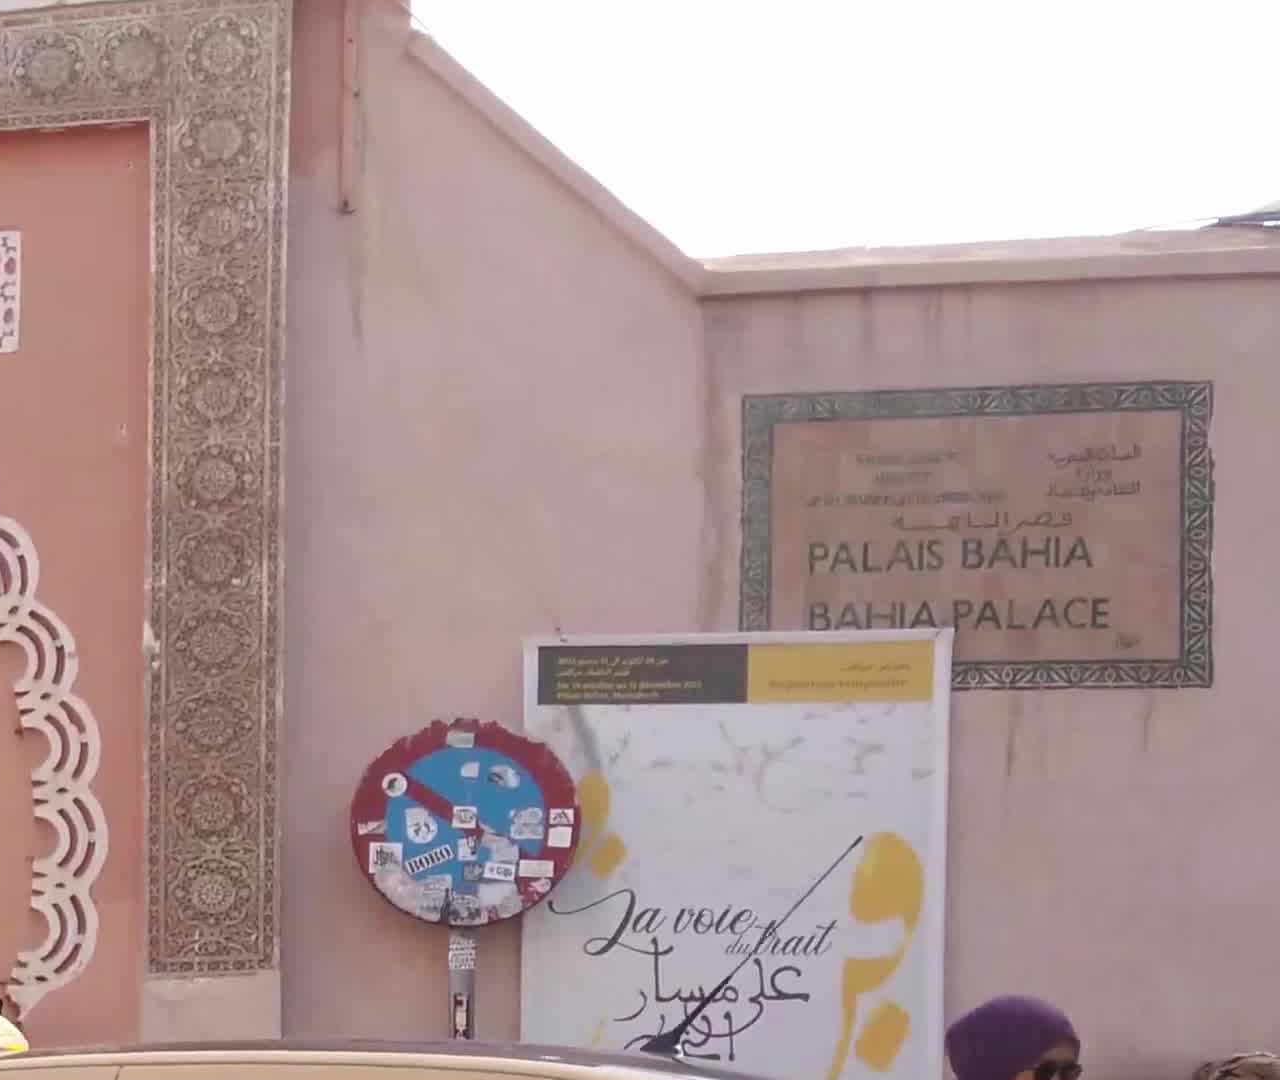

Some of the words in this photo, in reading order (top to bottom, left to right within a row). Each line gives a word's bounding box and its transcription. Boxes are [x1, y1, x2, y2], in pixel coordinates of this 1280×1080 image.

[806, 538, 945, 576] PALAIS
[960, 535, 1094, 571] BAHIA
[807, 600, 942, 632] BAHIA
[953, 598, 1111, 631] PALACE
[548, 888, 673, 956] La
[673, 902, 759, 935] voie
[725, 934, 752, 955] du
[752, 918, 838, 957] trait
